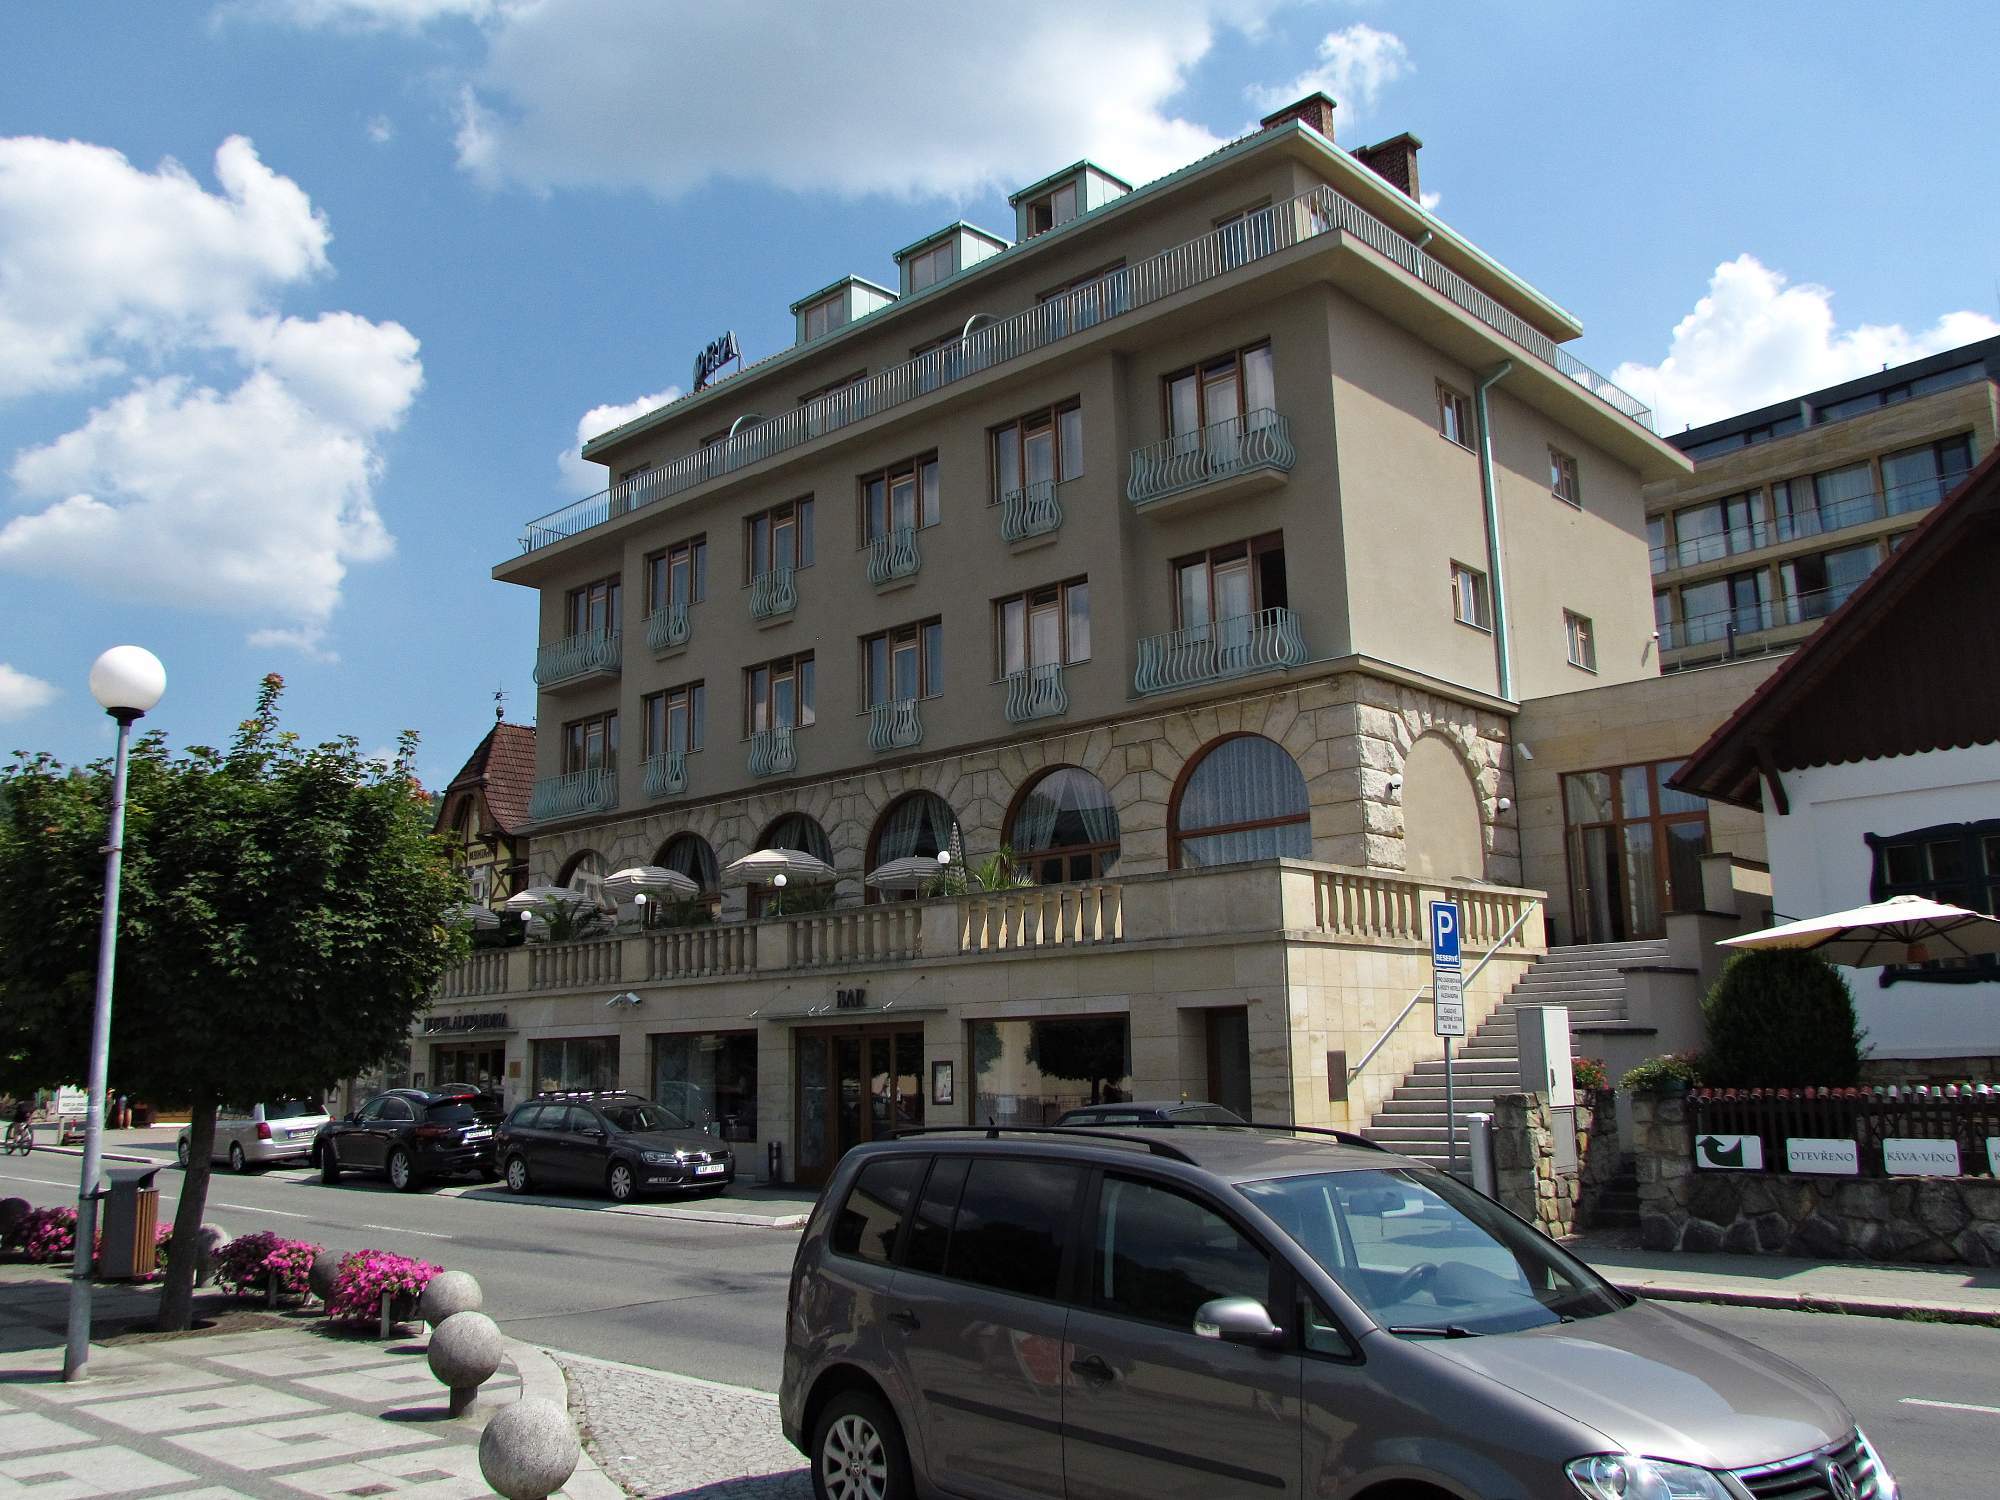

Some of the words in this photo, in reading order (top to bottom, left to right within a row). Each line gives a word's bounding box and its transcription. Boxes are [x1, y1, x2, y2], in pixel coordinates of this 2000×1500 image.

[1437, 910, 1453, 947] P
[836, 989, 866, 1008] BAR
[1790, 1150, 1854, 1161] OTEVŘENO
